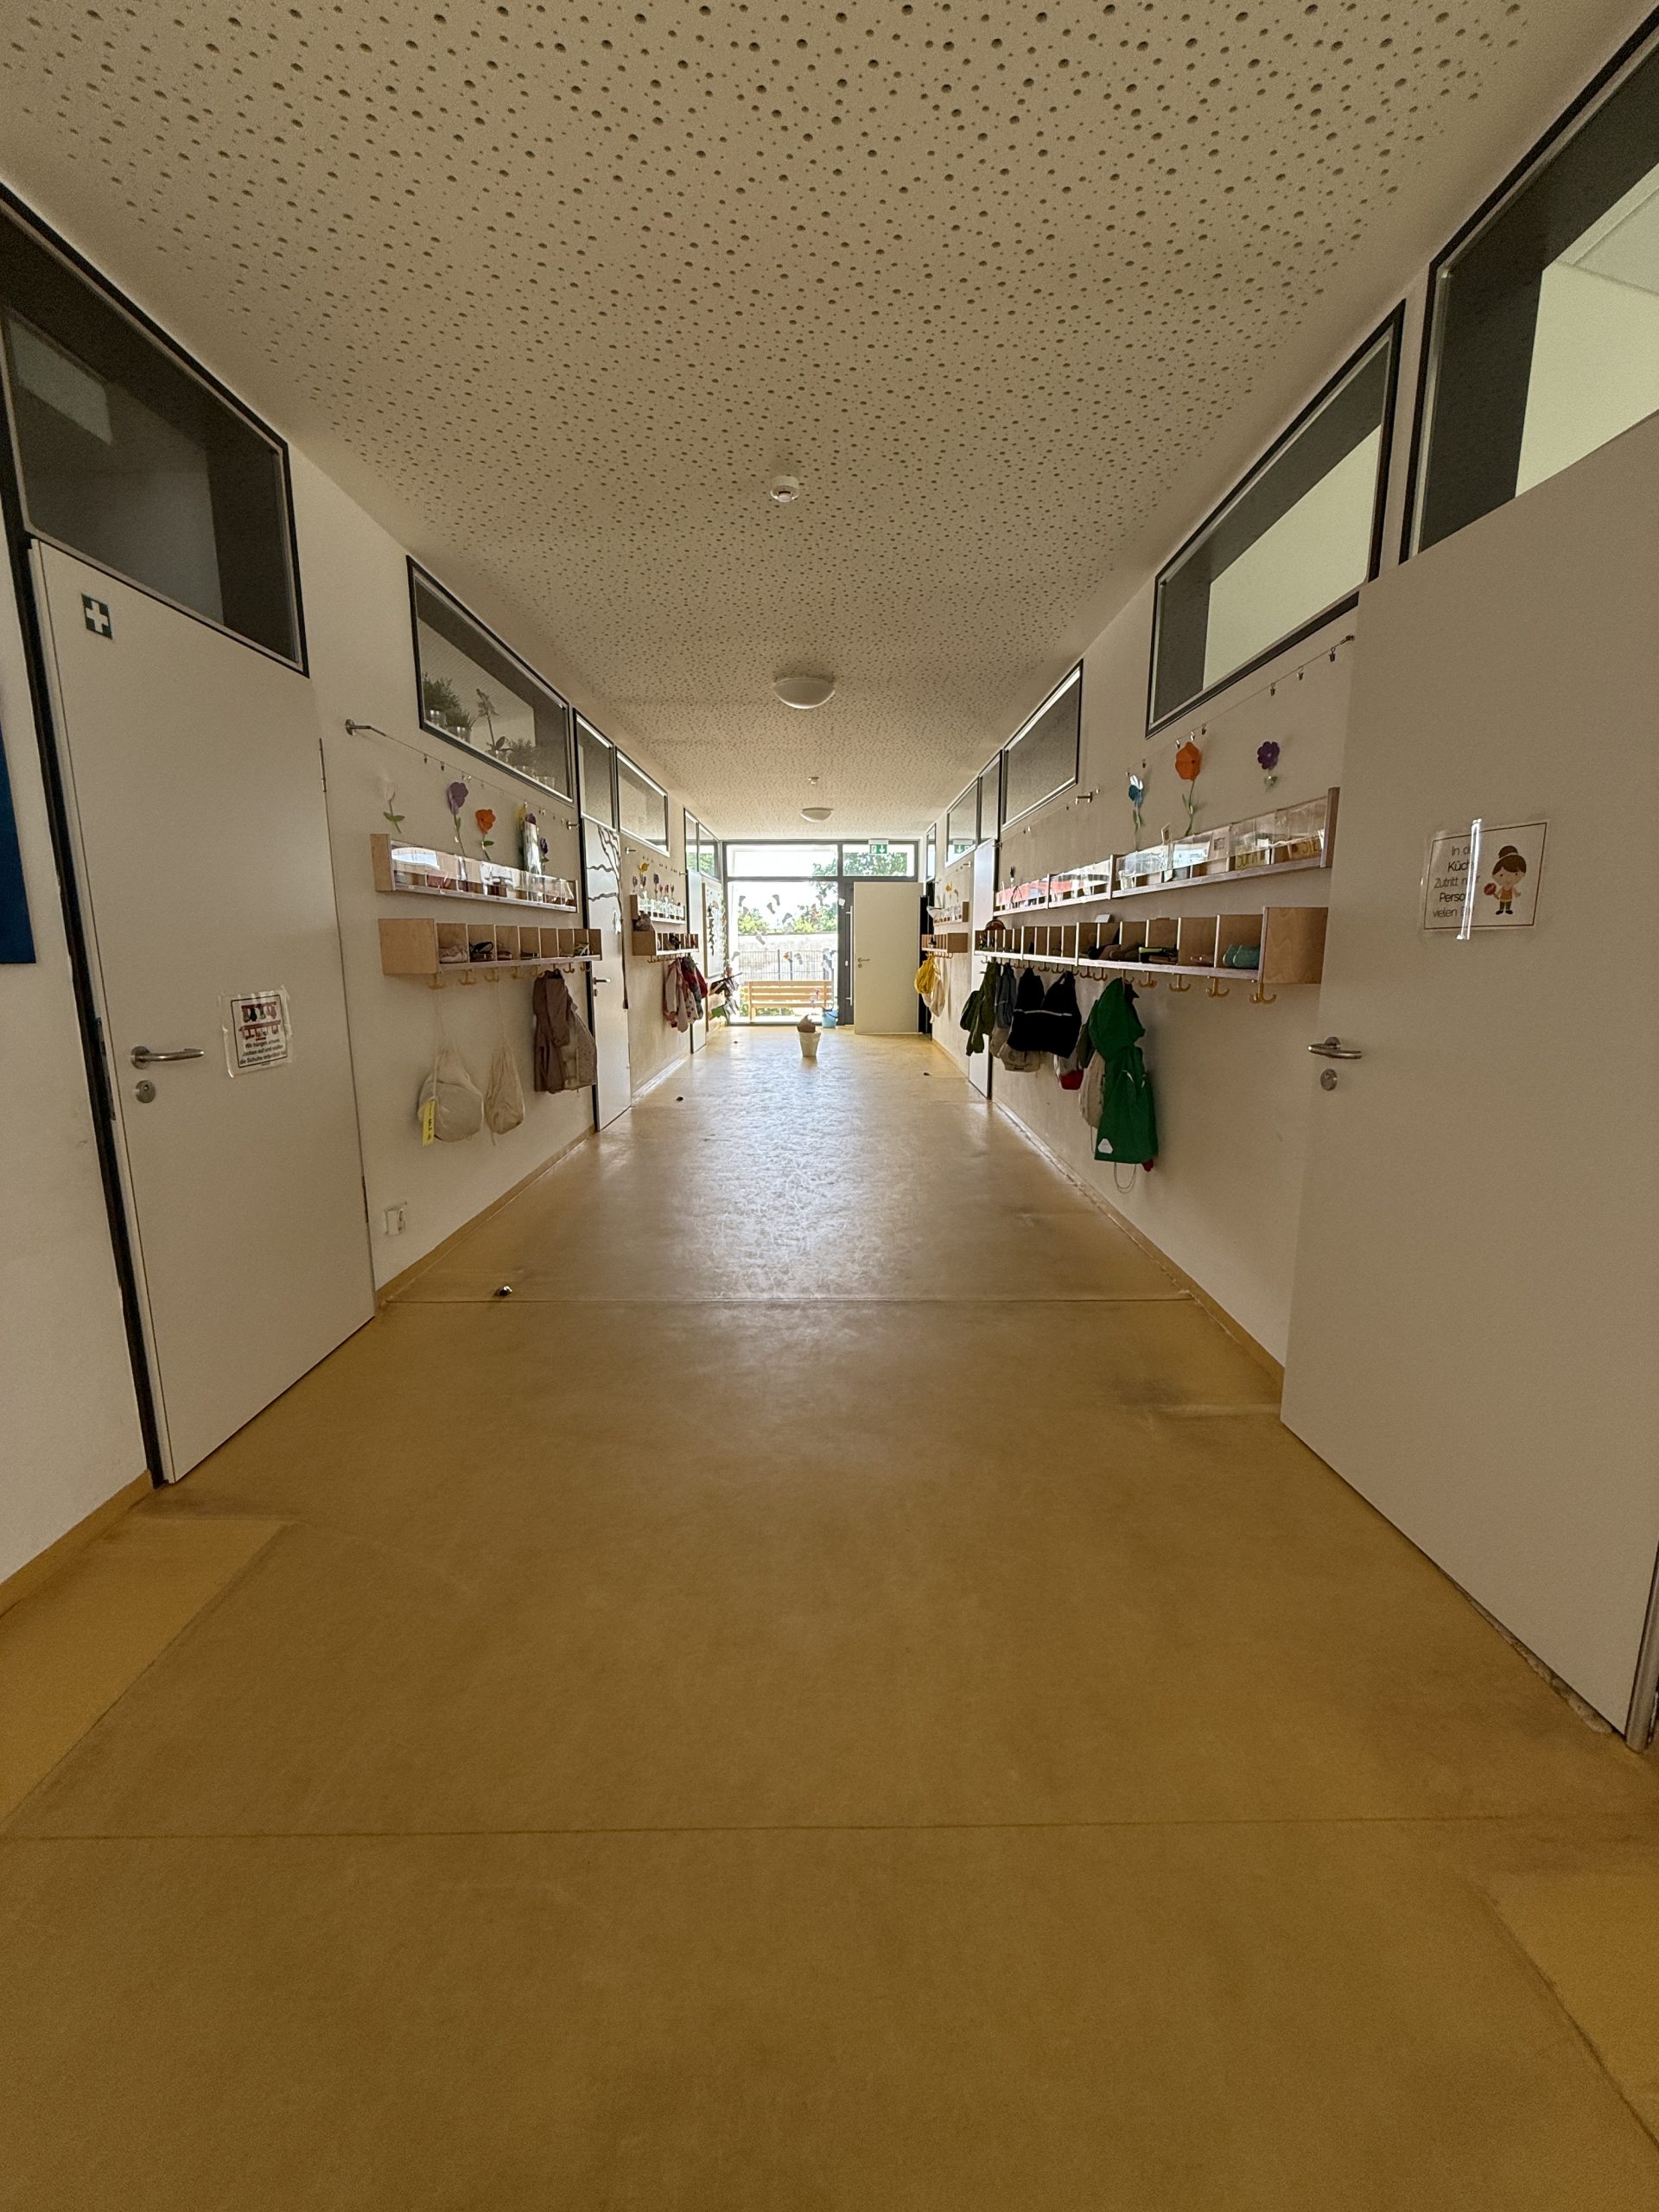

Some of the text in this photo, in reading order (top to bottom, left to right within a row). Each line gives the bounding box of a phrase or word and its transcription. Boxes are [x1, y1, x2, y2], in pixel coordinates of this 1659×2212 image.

[1452, 846, 1459, 855] In
[1433, 874, 1480, 888] Zutritt nr
[1439, 893, 1467, 903] Perso
[1433, 907, 1458, 918] vielen
